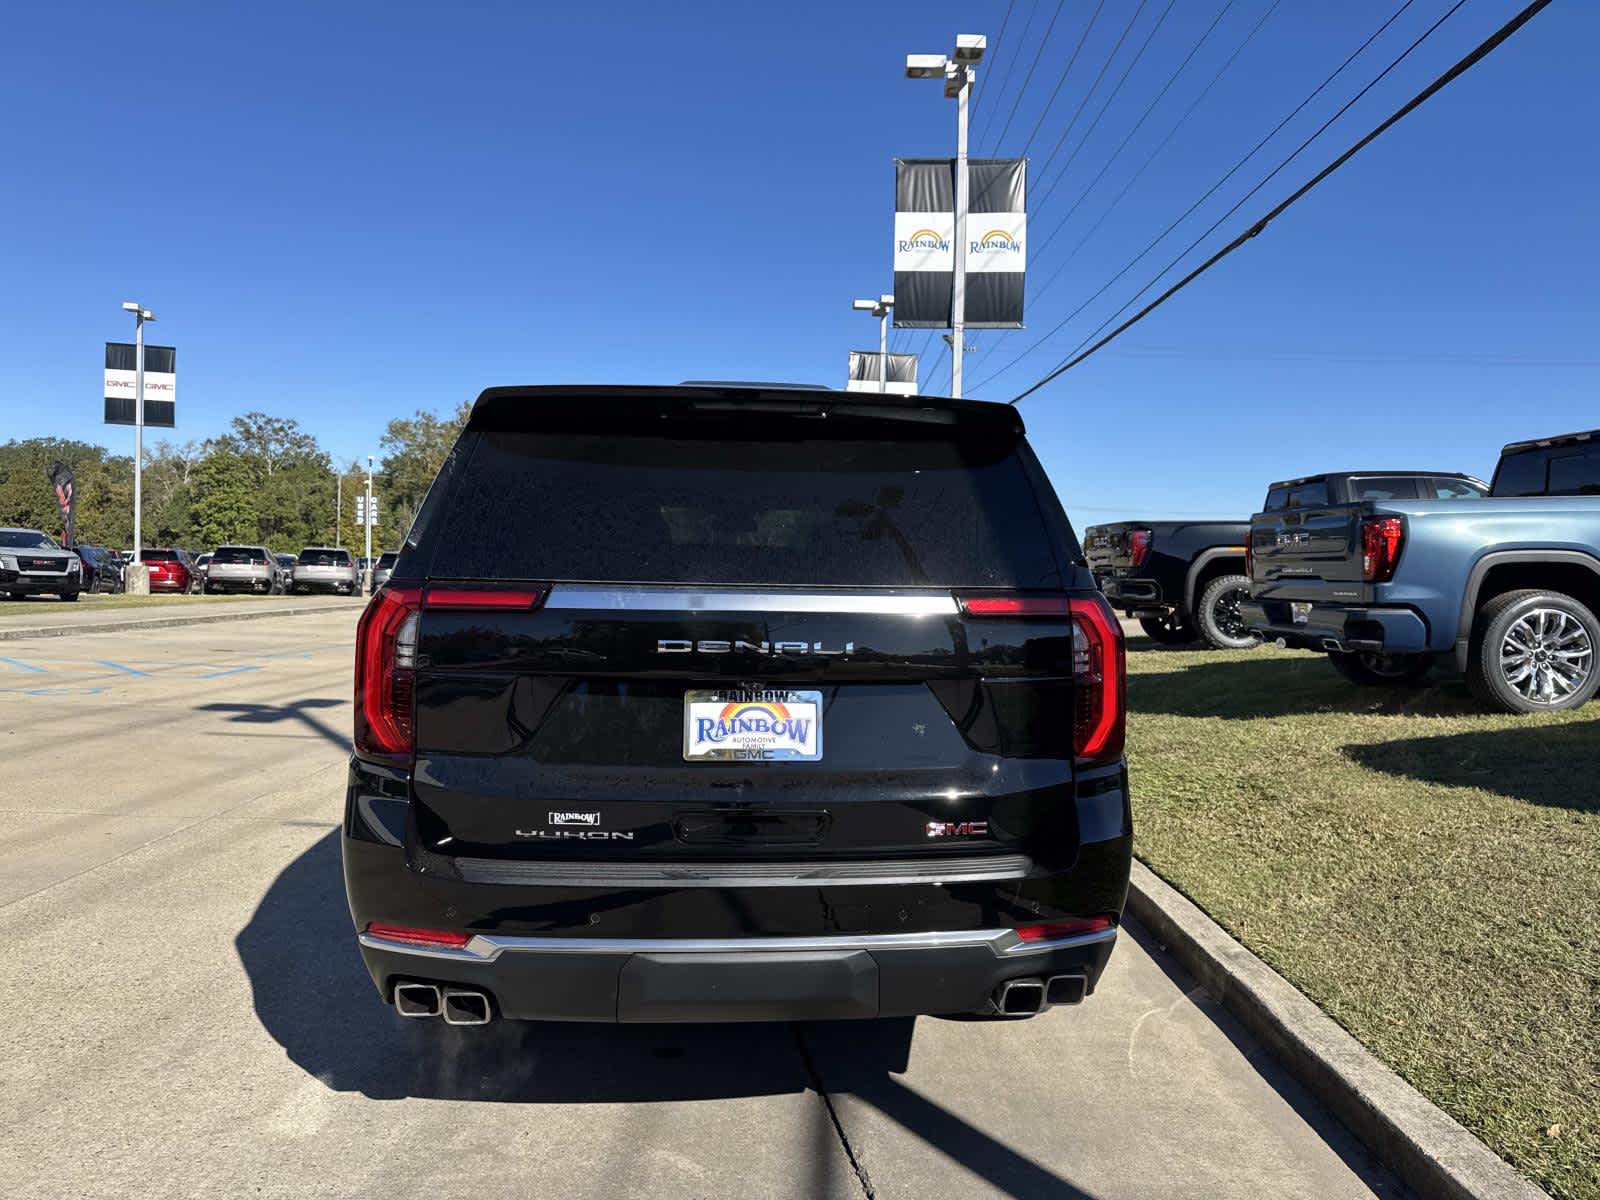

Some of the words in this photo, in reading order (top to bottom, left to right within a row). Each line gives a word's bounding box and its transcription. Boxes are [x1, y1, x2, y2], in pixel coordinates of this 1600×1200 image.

[899, 240, 950, 253] RAINBOW
[970, 241, 1021, 254] RAINBOW
[657, 639, 855, 655] DENALI
[717, 690, 791, 703] RAINBOW
[696, 717, 811, 745] RAINBOW
[732, 736, 777, 744] AUTOMOTIVE
[742, 743, 767, 751] FAMILY
[734, 750, 775, 760] GMC
[553, 812, 595, 825] RAINBOW
[515, 829, 634, 841] YUKON
[926, 821, 988, 837] GMC
